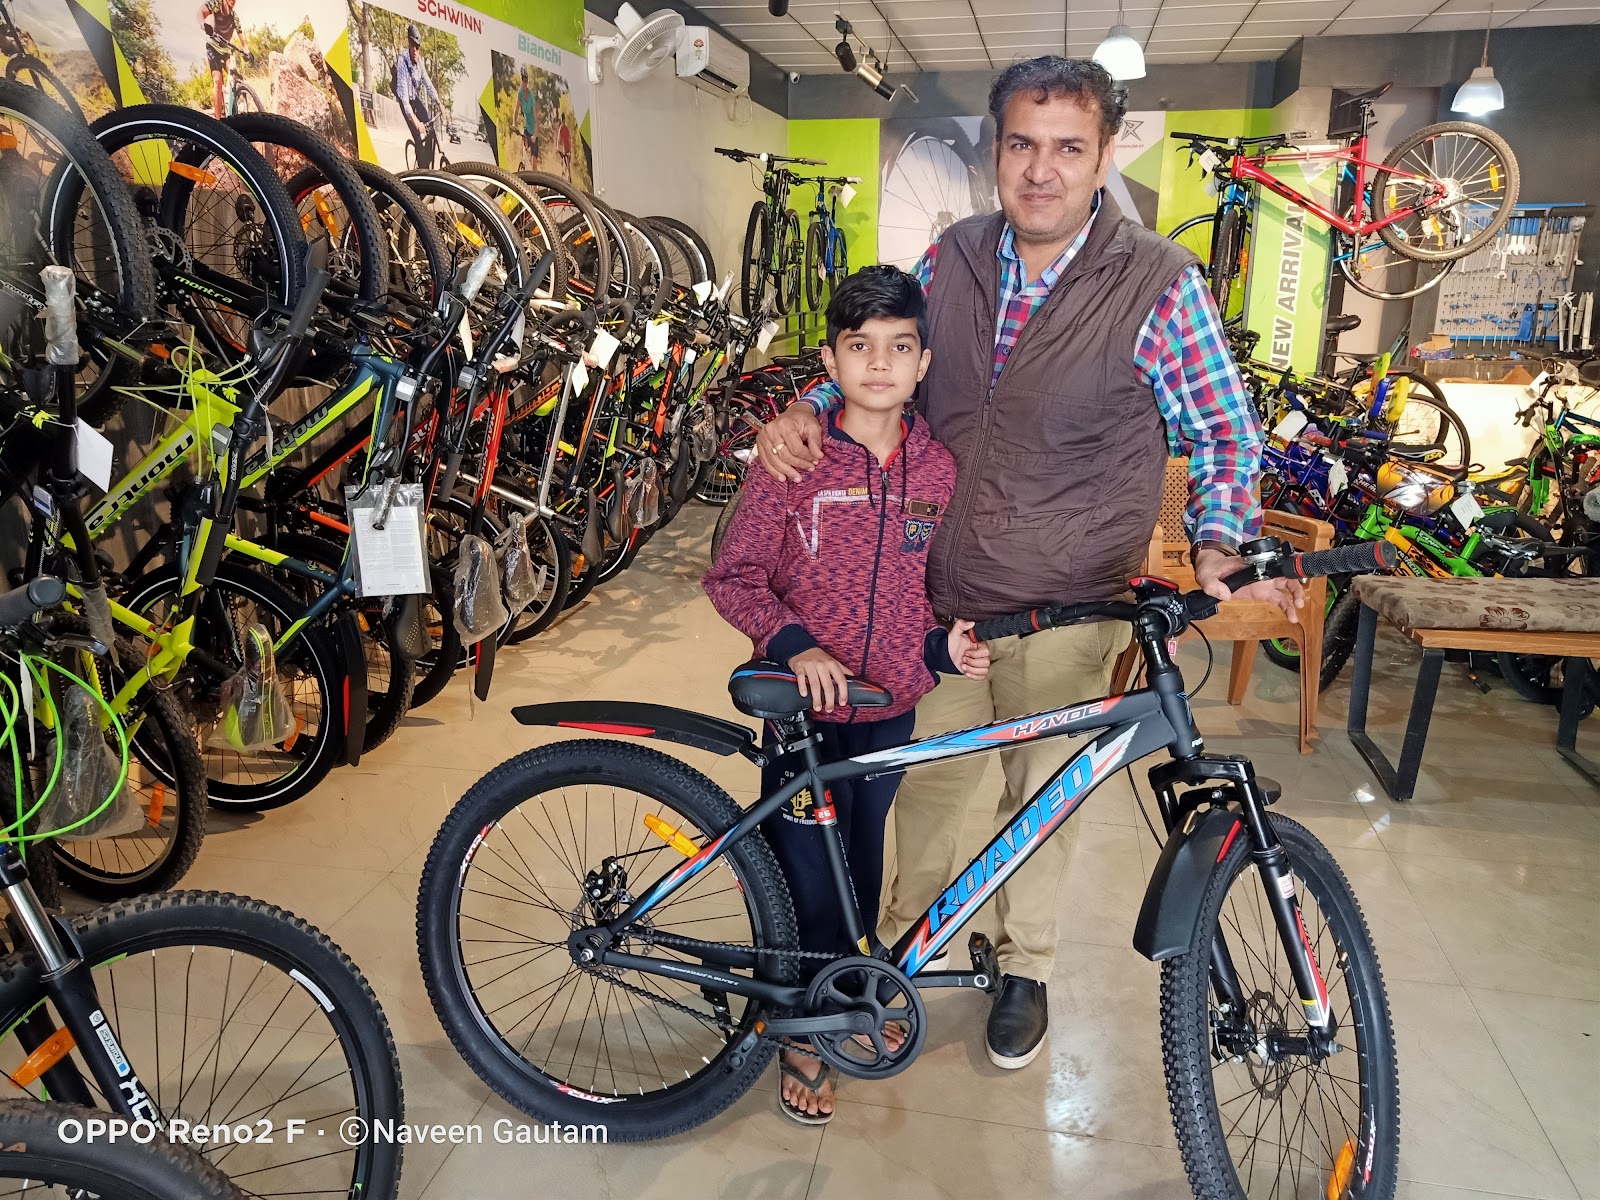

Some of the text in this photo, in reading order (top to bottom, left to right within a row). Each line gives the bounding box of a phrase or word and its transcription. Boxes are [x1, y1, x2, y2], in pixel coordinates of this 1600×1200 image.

[418, 0, 482, 34] SCHWINN
[517, 34, 562, 66] Bianchi
[174, 275, 233, 303] montra
[1424, 451, 1442, 463] BSA
[88, 433, 195, 532] montra
[848, 487, 868, 496] DENIM
[1012, 700, 1105, 738] HAVOC
[817, 810, 831, 819] 26
[927, 754, 1093, 935] ROADEO
[119, 1076, 164, 1133] XC
